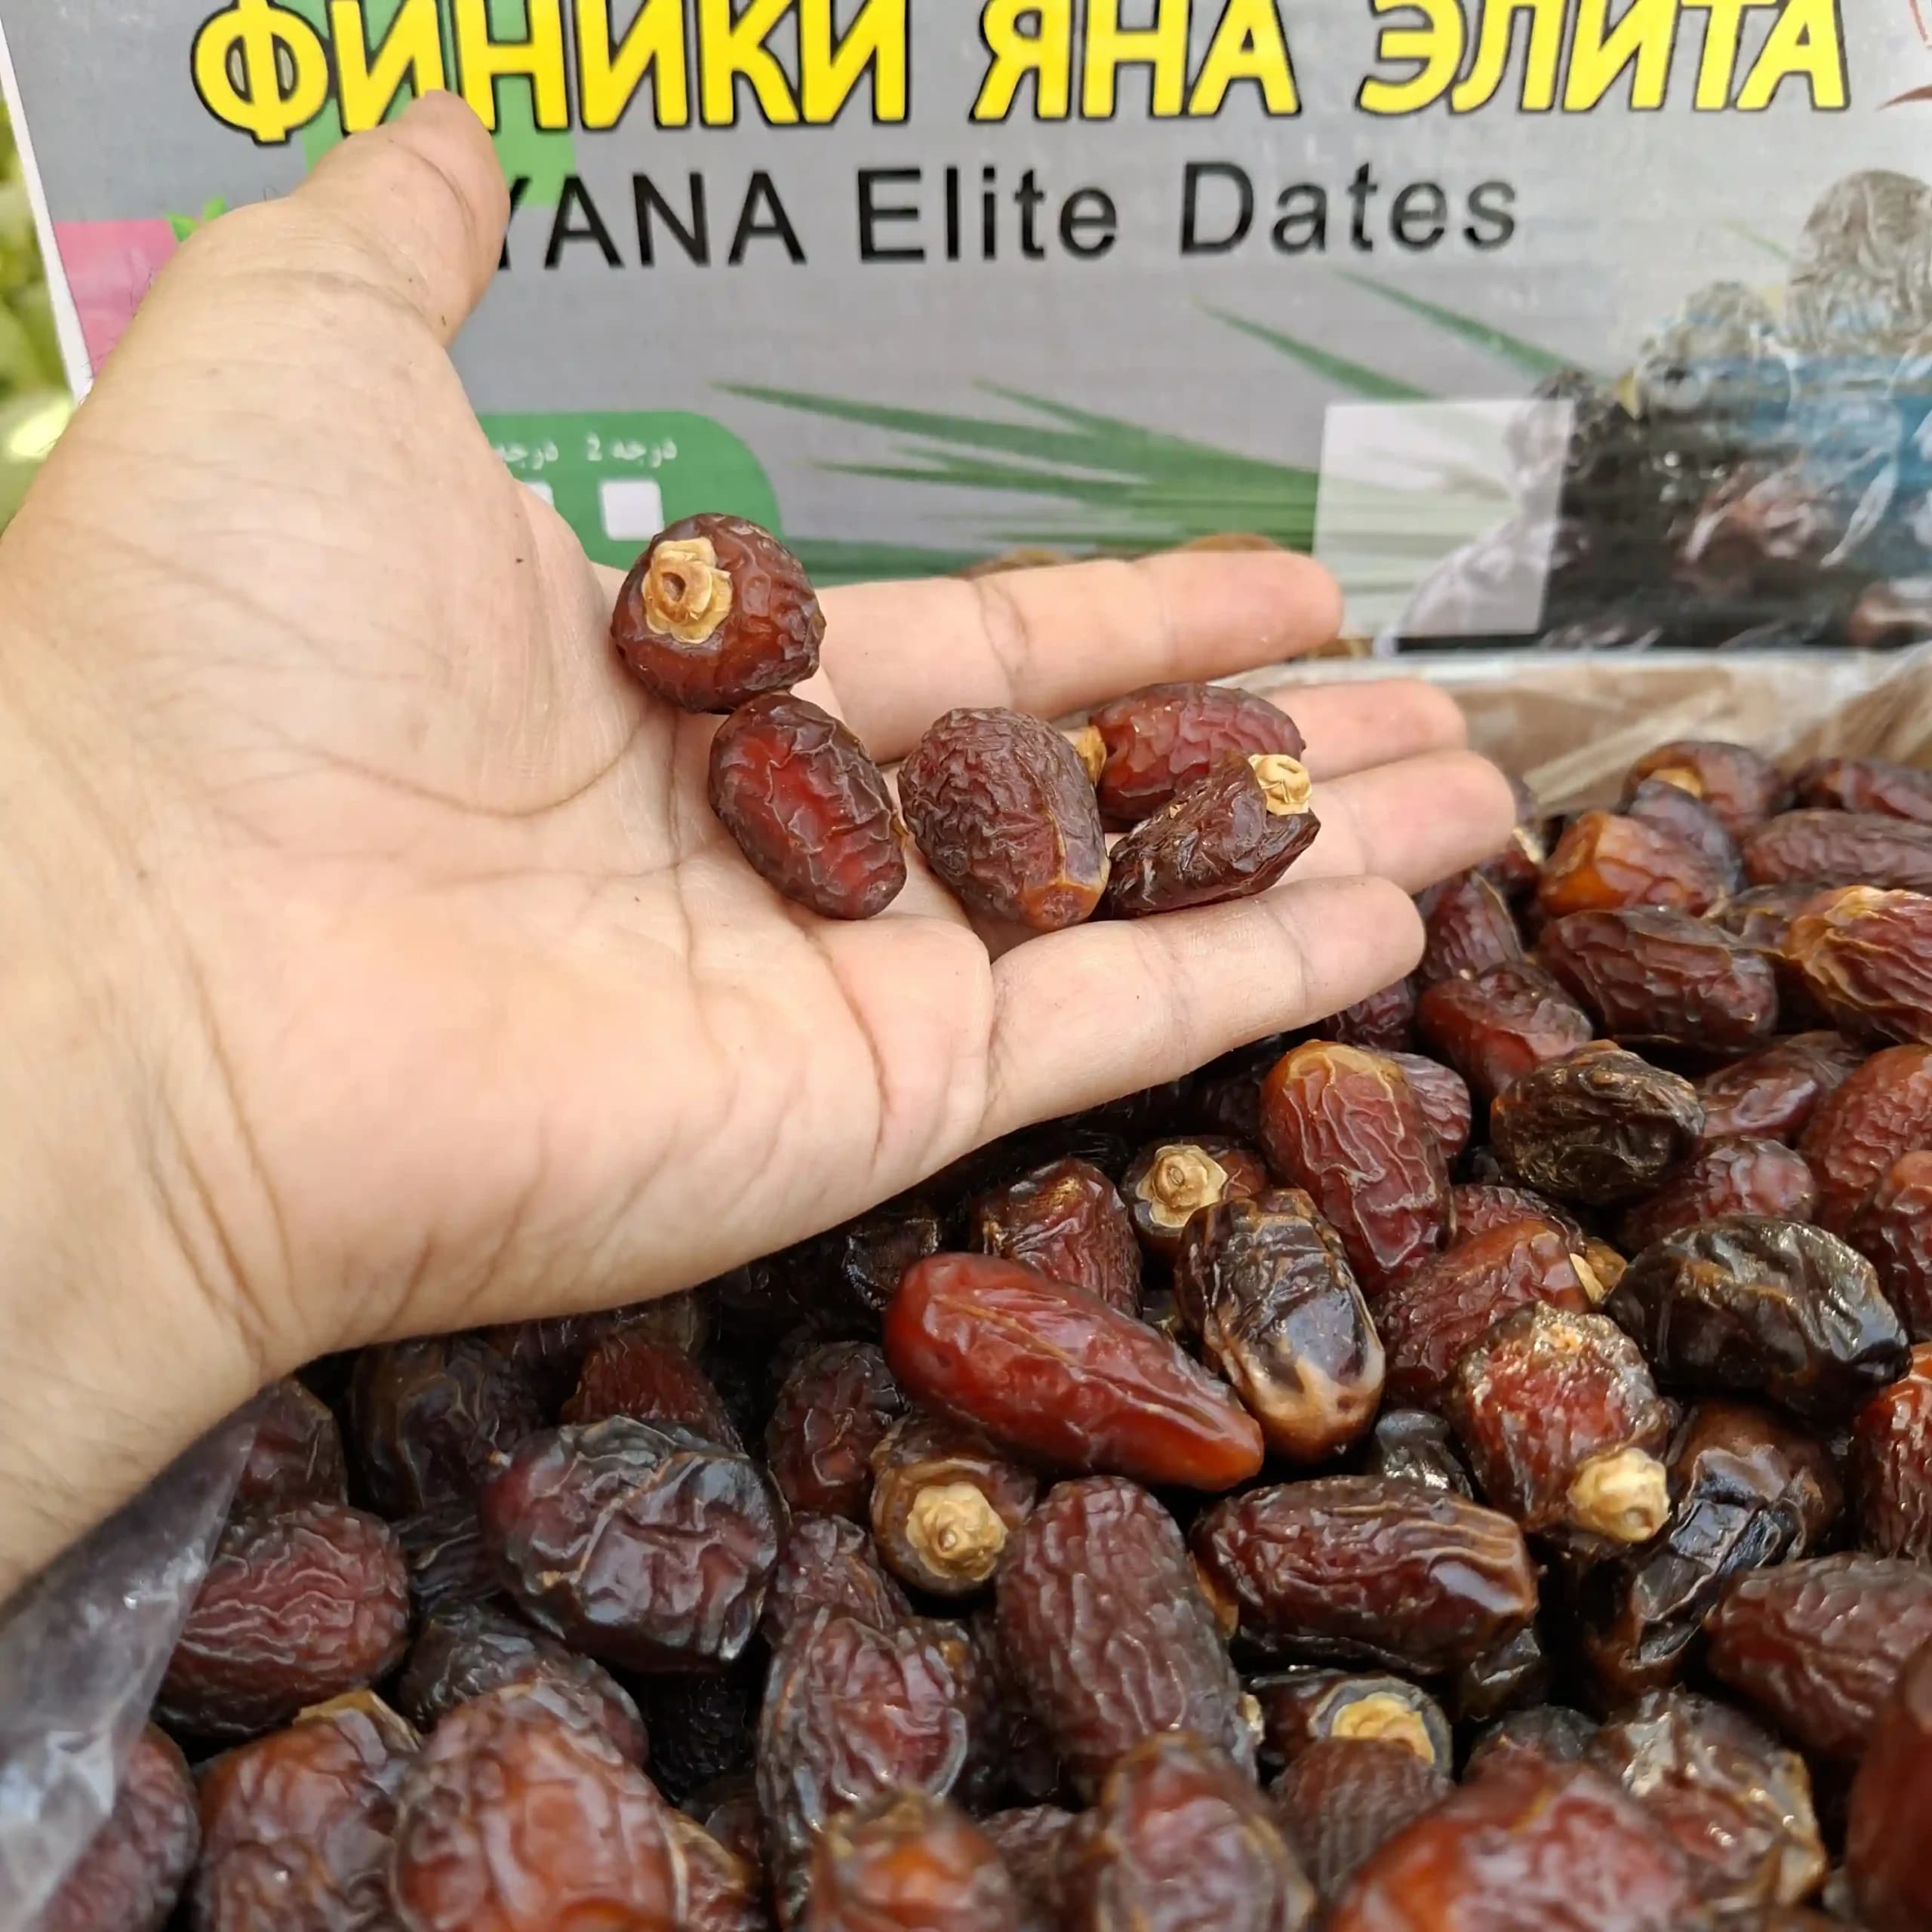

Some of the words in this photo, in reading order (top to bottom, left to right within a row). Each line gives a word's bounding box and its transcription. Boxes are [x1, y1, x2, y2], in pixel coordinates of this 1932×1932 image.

[191, 0, 912, 145] ФИНИКИ
[968, 0, 1303, 123] ЯНА
[1355, 0, 1851, 115] ЭЛИТА
[856, 166, 1118, 261] Elite
[1180, 161, 1518, 254] Dates
